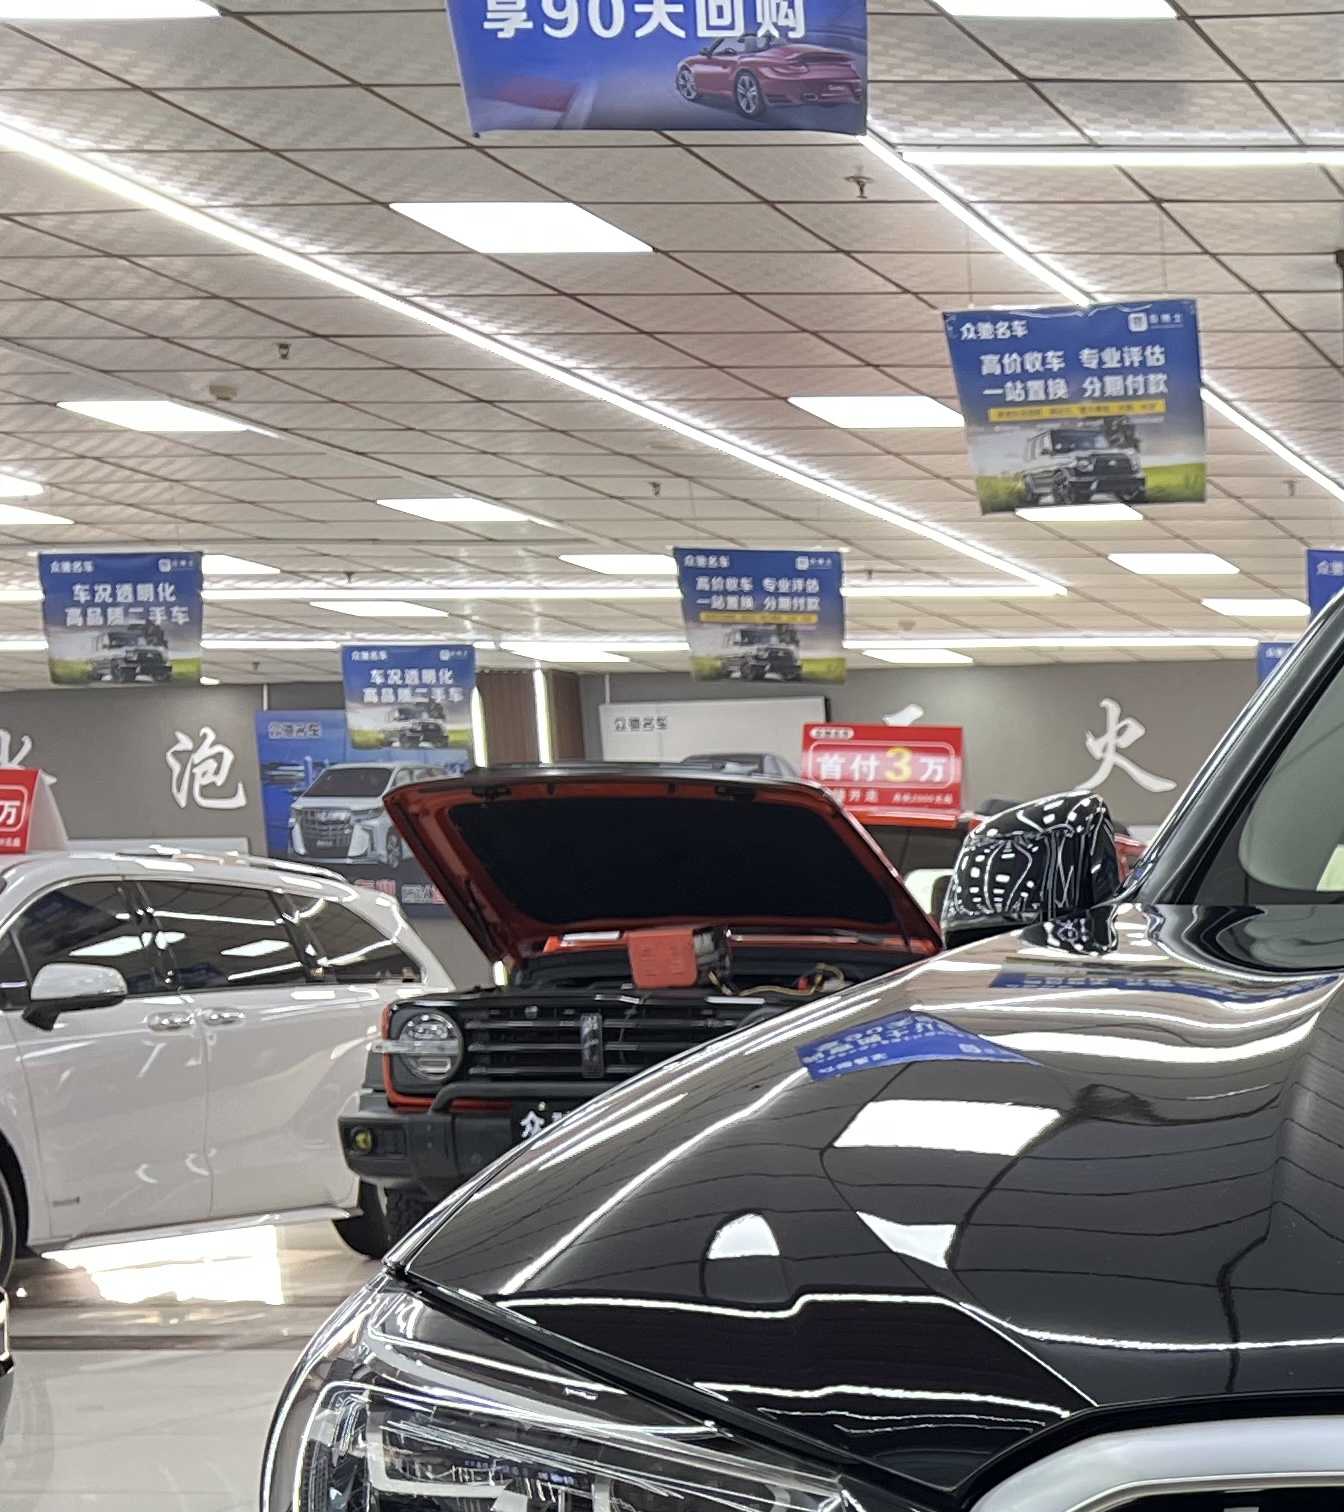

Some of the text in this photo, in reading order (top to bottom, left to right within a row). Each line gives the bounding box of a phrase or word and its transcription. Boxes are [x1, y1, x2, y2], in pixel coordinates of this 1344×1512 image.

[959, 320, 1028, 340] 众驰名车
[979, 344, 1166, 376] 高价收车 专业评估
[982, 373, 1168, 402] 一站置换 分期付款
[72, 582, 177, 604] 车况透明化
[65, 605, 190, 627] 高品质二手车
[166, 726, 247, 809] 泡
[816, 746, 948, 783] 首付3万
